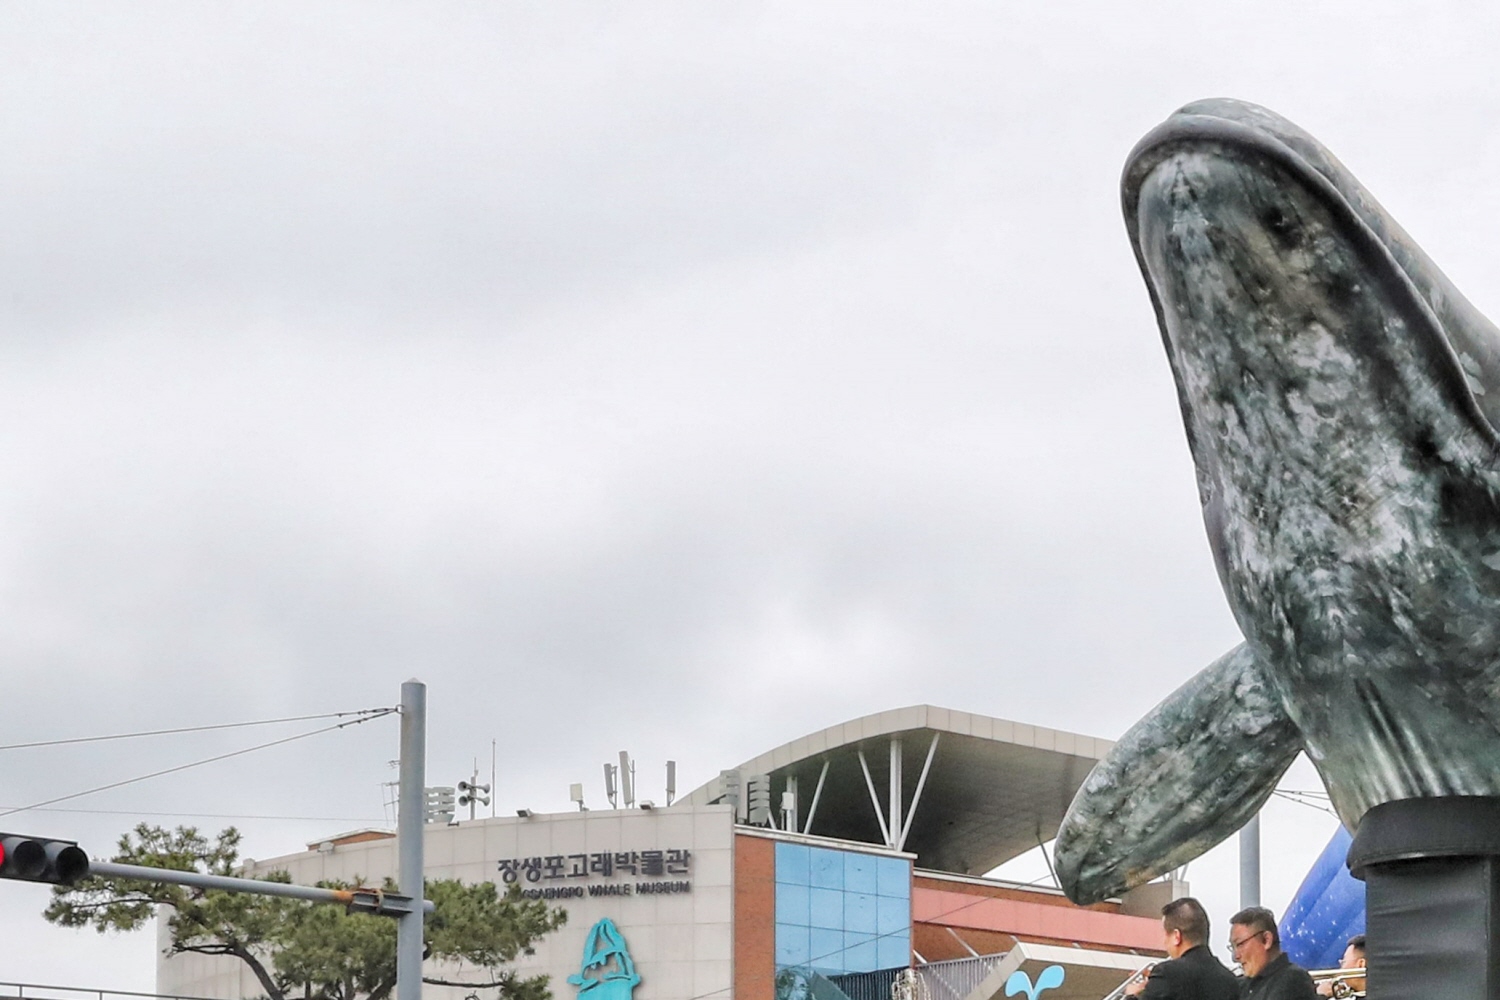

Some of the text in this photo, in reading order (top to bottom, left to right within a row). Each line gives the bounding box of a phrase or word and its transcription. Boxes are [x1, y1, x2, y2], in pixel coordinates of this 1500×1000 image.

[498, 849, 691, 884] 장생포고래박물관
[587, 883, 631, 897] WHALE
[635, 880, 691, 895] MUSEUM
